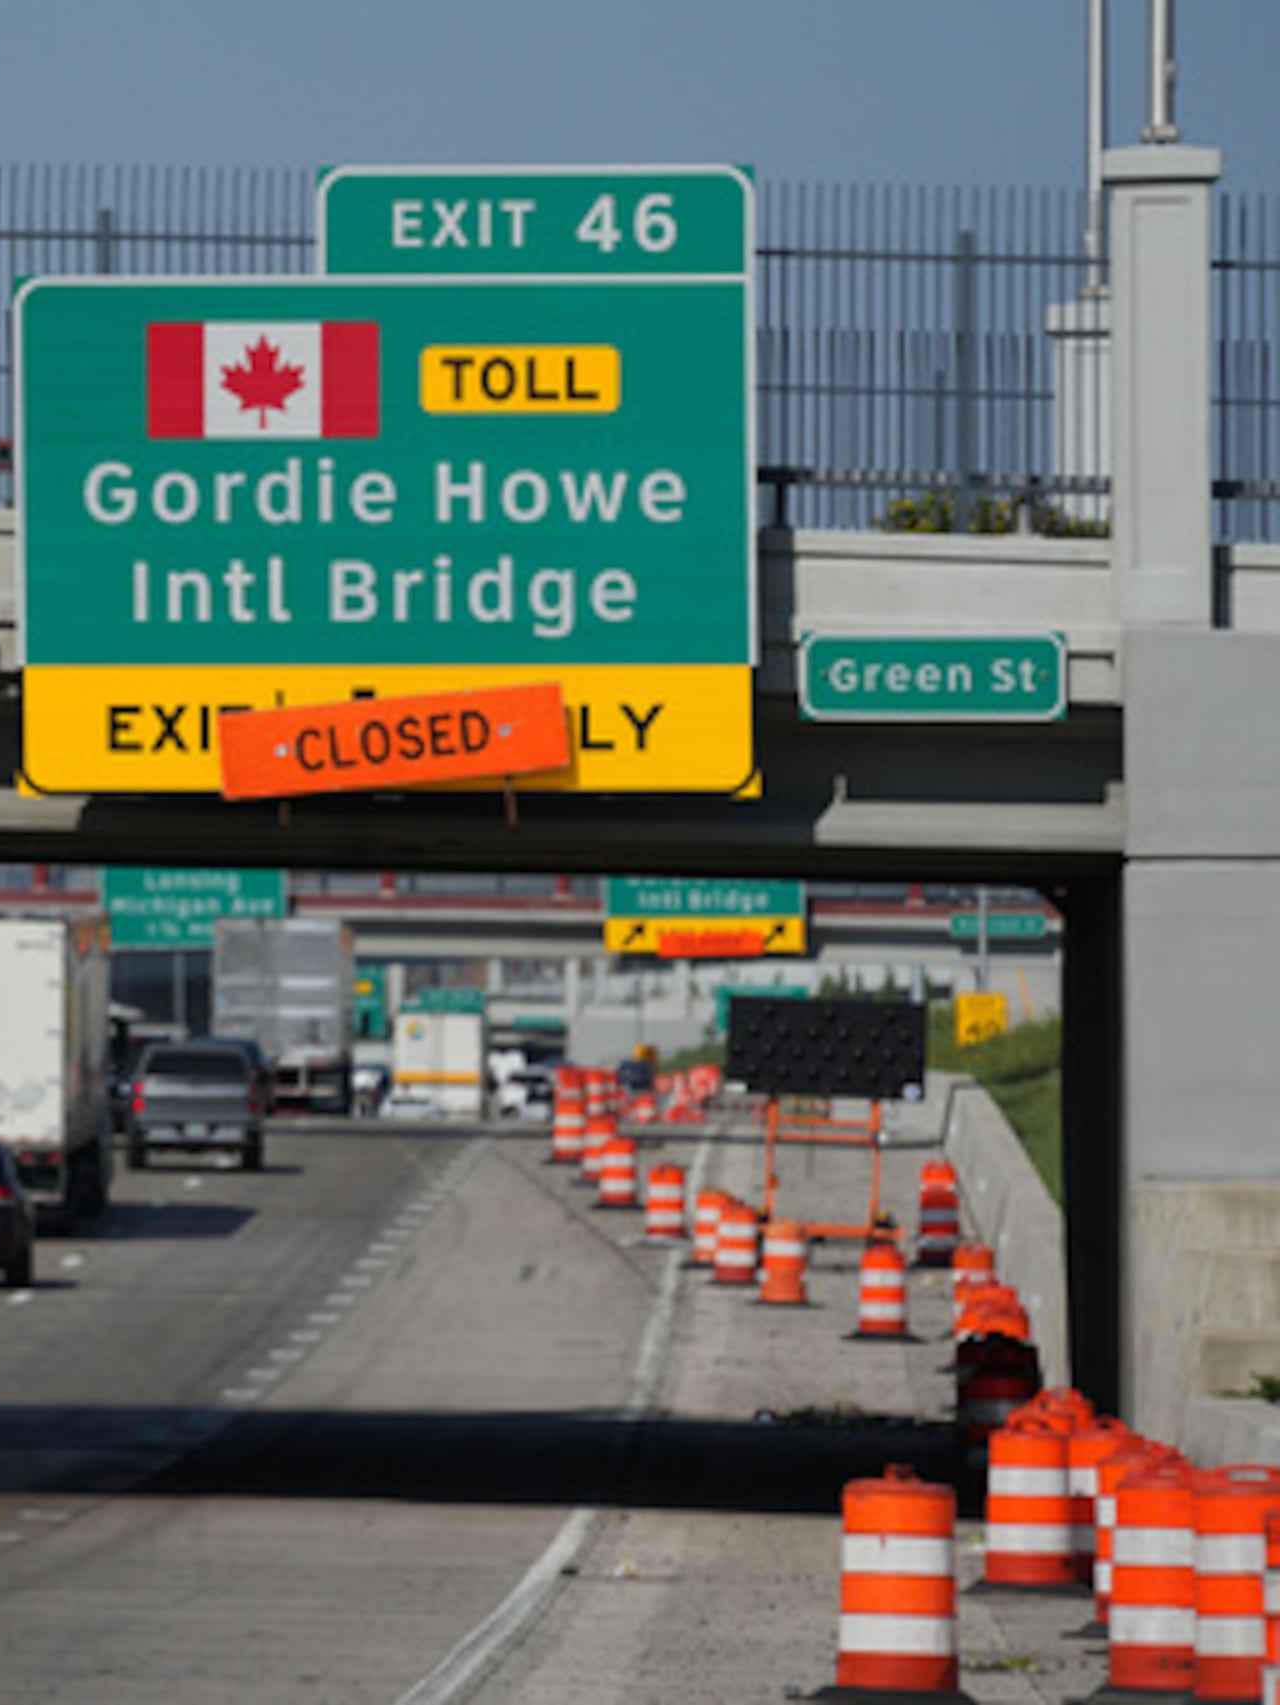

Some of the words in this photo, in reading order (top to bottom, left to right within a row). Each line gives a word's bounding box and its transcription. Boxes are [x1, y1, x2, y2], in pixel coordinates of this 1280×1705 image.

[389, 200, 536, 249] EXIT
[575, 193, 679, 252] 46
[440, 356, 600, 401] TOLL
[82, 457, 398, 524] Gordie
[434, 461, 688, 524] Howe
[131, 556, 292, 623] Intl
[328, 555, 639, 639] Bridge
[827, 657, 973, 693] Green
[990, 657, 1038, 693] St
[106, 703, 254, 753] EXI
[293, 709, 492, 773] CLOSED
